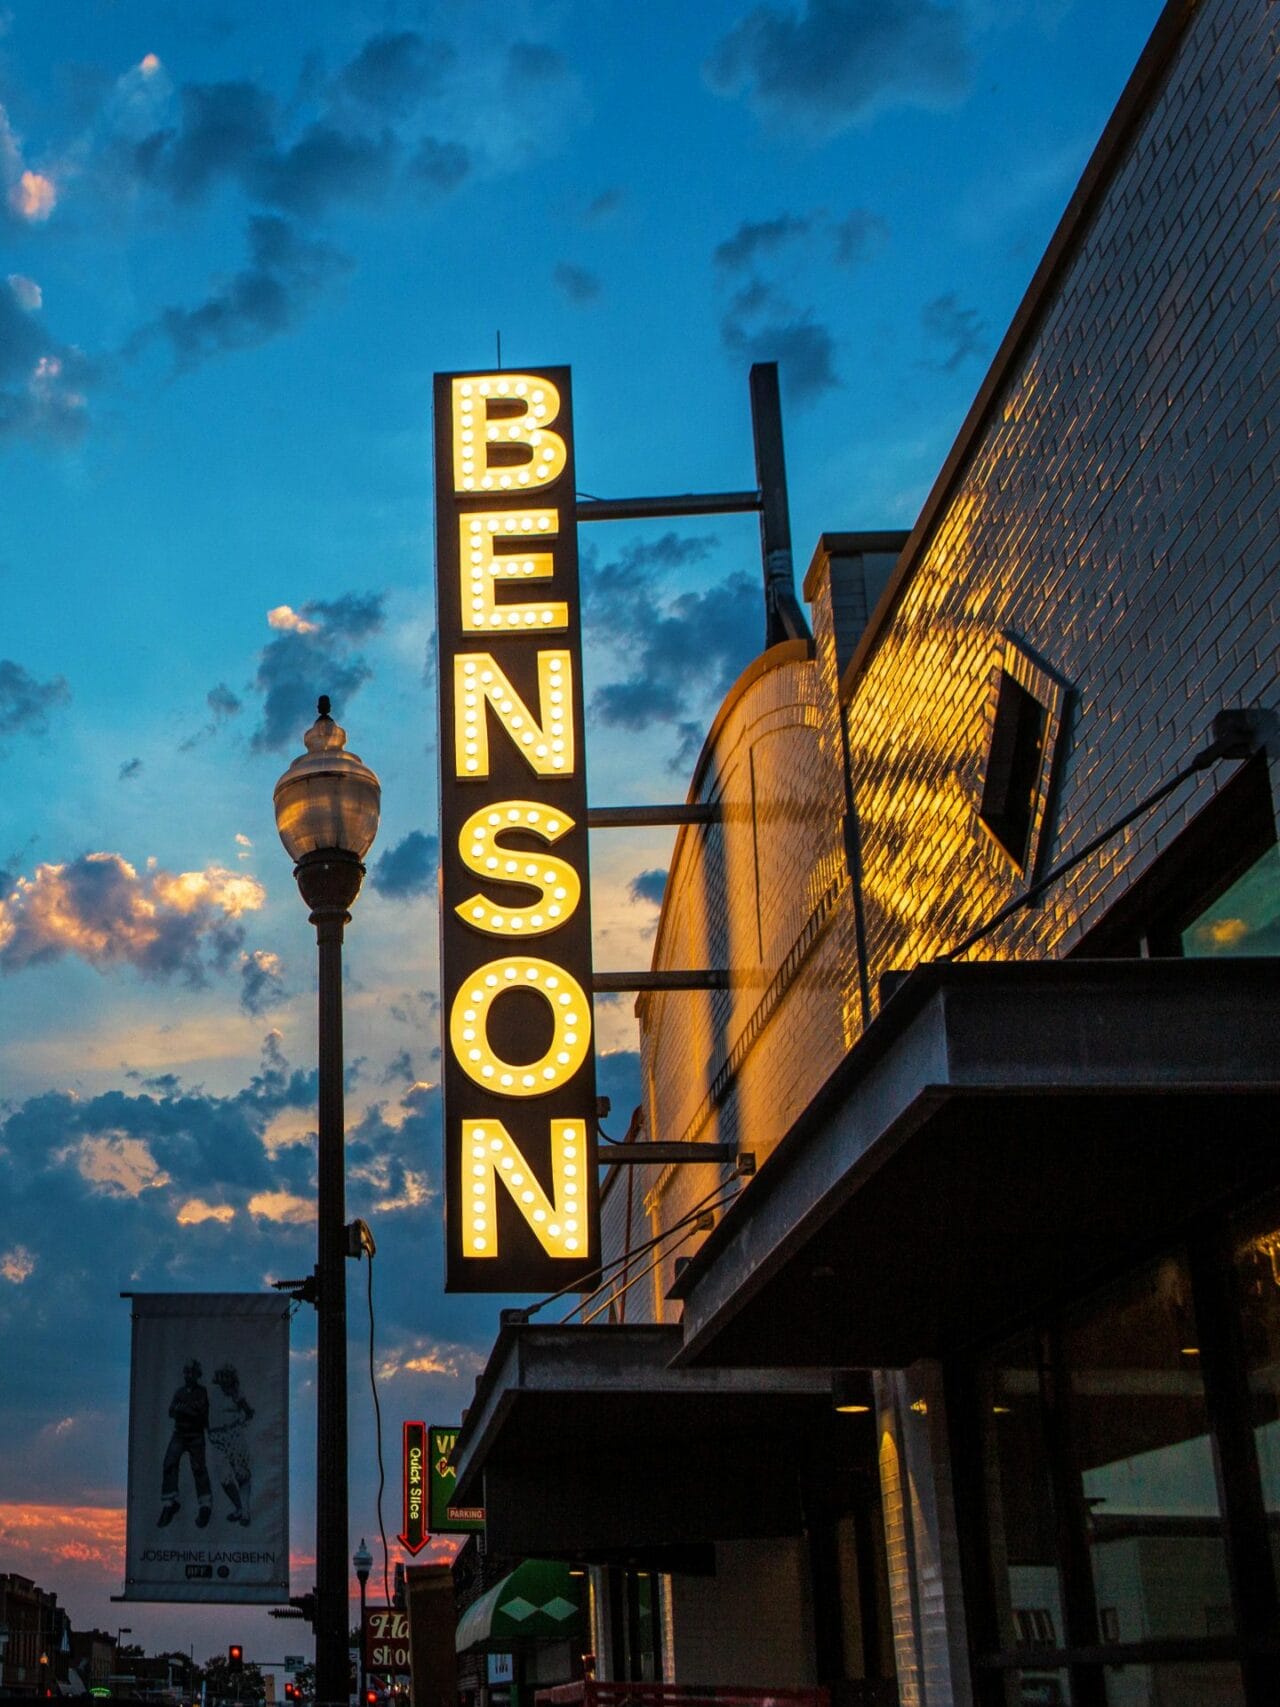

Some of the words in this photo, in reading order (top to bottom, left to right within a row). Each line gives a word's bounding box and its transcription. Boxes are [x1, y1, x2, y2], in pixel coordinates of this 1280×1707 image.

[449, 375, 593, 1260] BENSON
[409, 1447, 423, 1485] Quick
[409, 1487, 423, 1520] Slice
[449, 1509, 483, 1520] PARKING
[140, 1550, 206, 1562] JOSEPHINE
[208, 1551, 275, 1564] LANGBEHN
